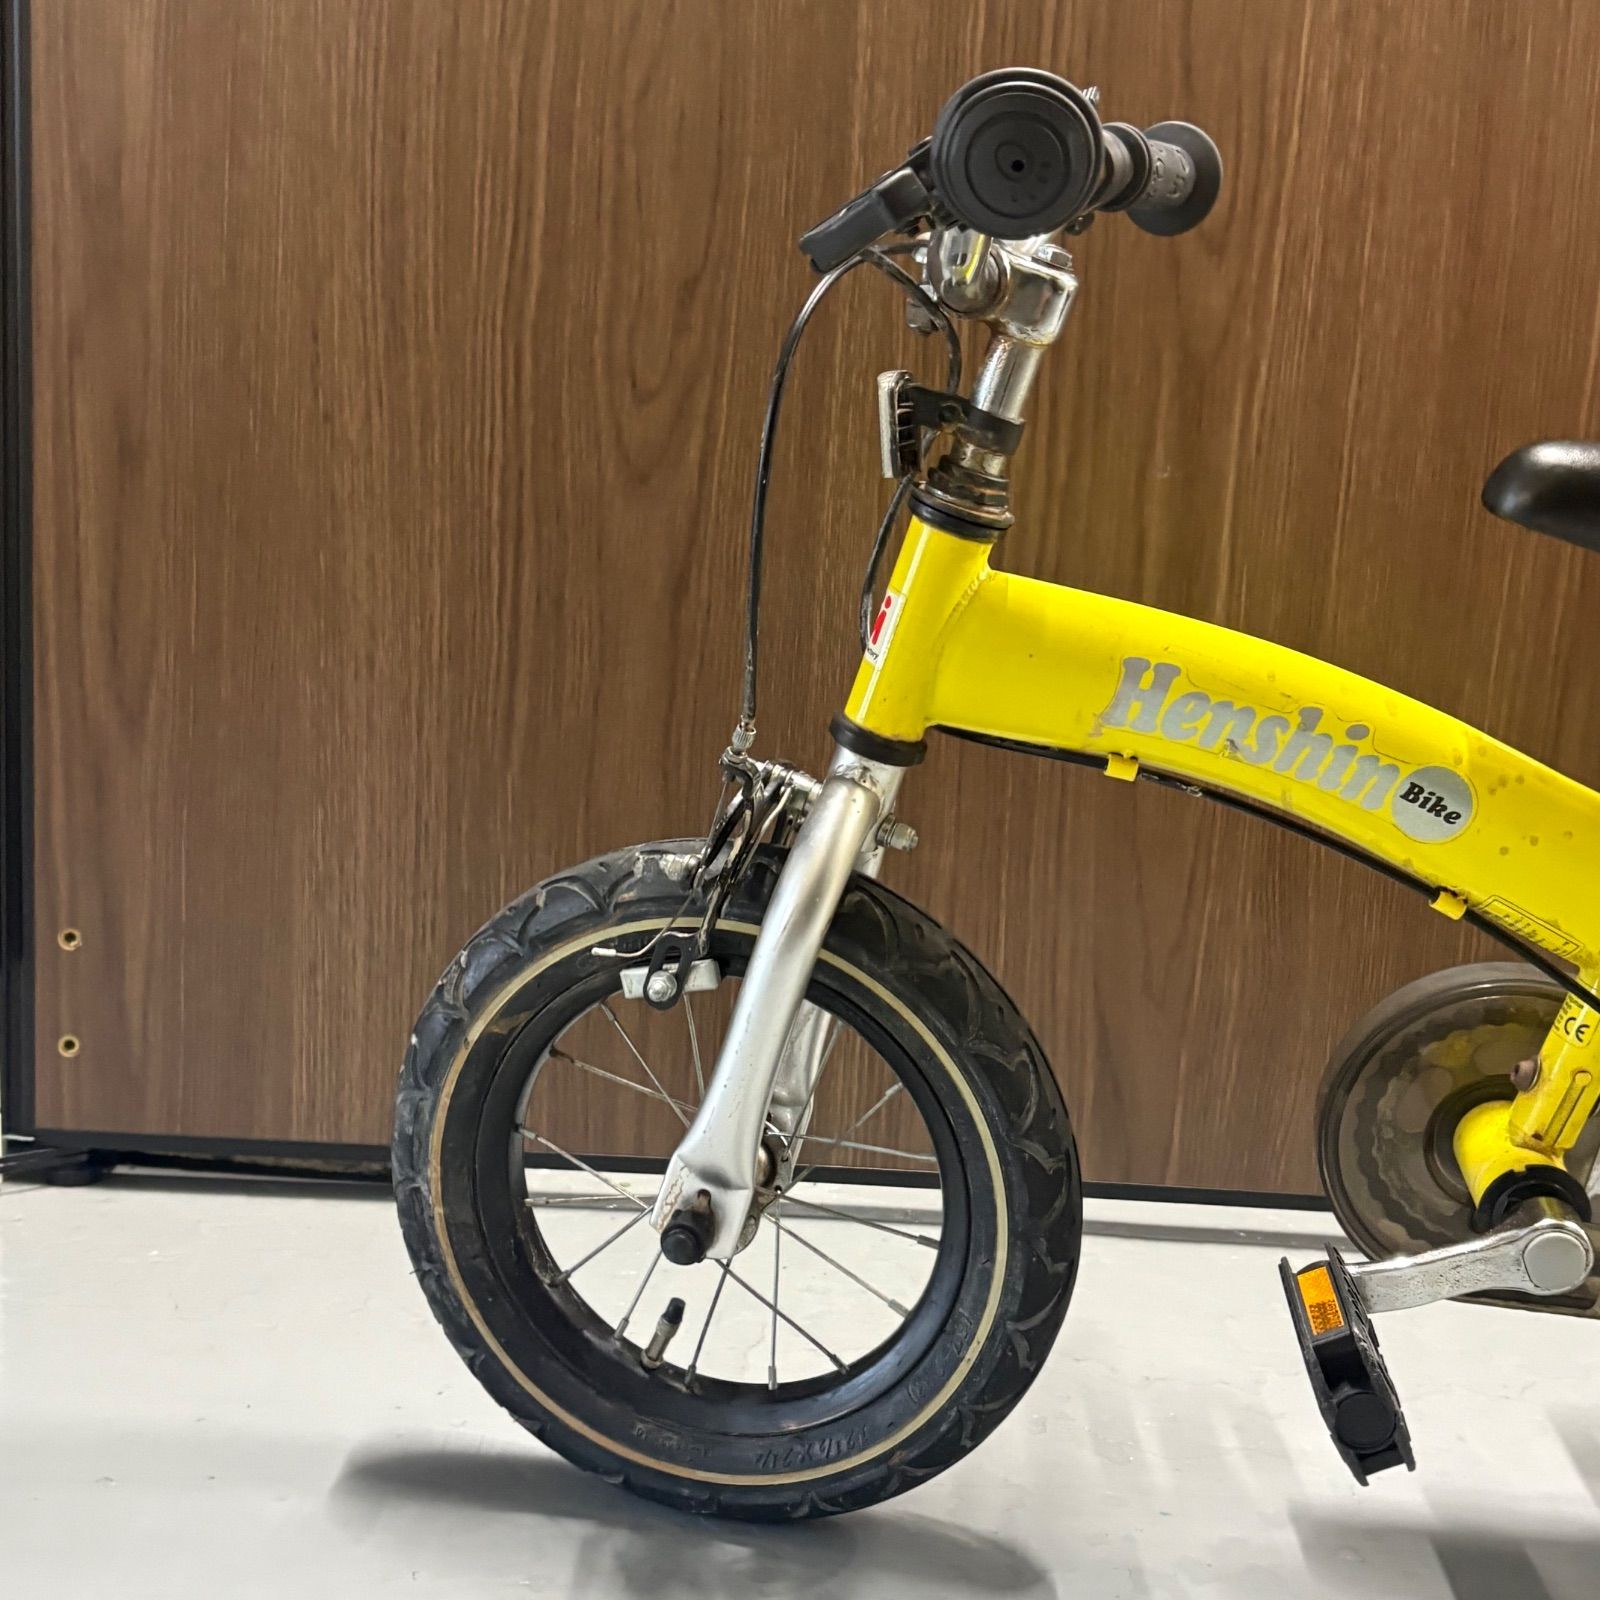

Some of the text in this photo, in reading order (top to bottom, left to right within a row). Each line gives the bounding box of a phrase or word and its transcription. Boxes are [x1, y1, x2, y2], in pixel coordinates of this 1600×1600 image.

[1101, 657, 1462, 825] Henshin Bike
[1563, 1017, 1590, 1043] CE
